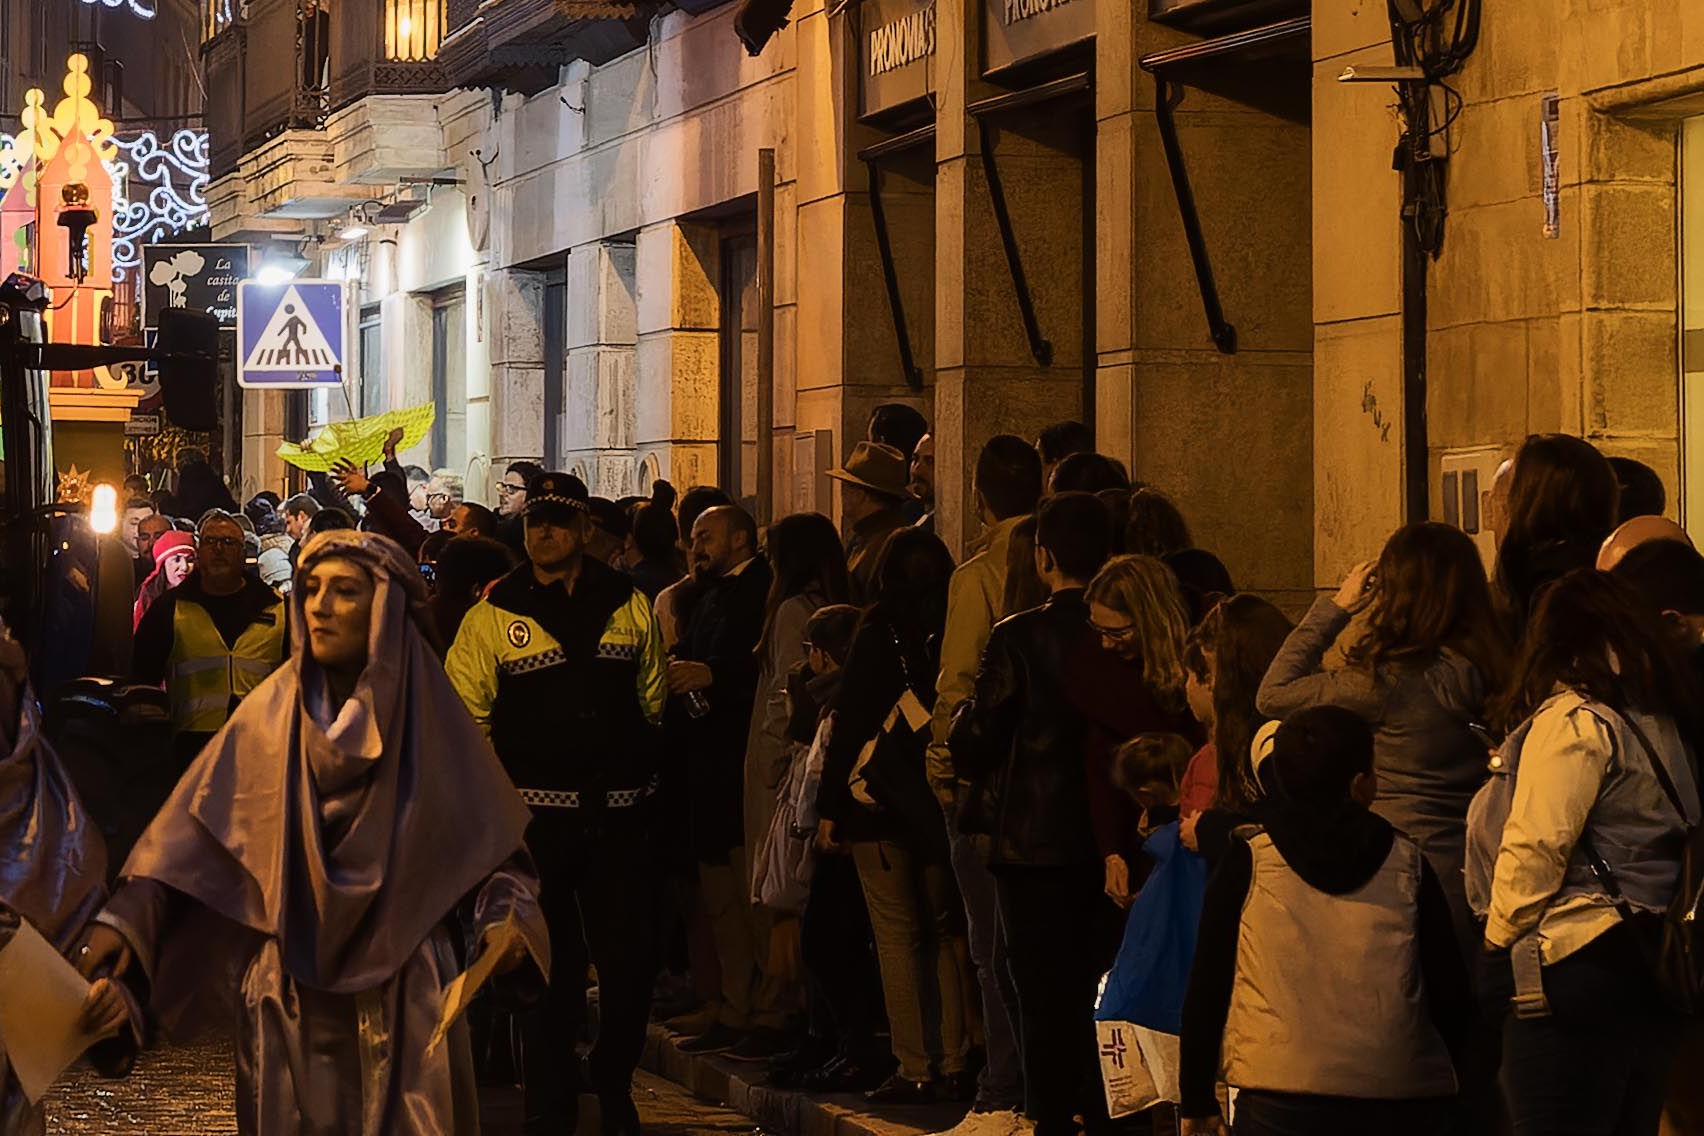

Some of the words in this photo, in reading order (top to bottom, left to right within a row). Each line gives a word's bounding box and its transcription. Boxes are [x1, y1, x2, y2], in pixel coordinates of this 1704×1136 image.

[870, 8, 936, 76] PRONOVIAS
[215, 258, 231, 270] La
[207, 273, 240, 286] casita
[217, 289, 230, 302] de
[205, 305, 238, 322] upit
